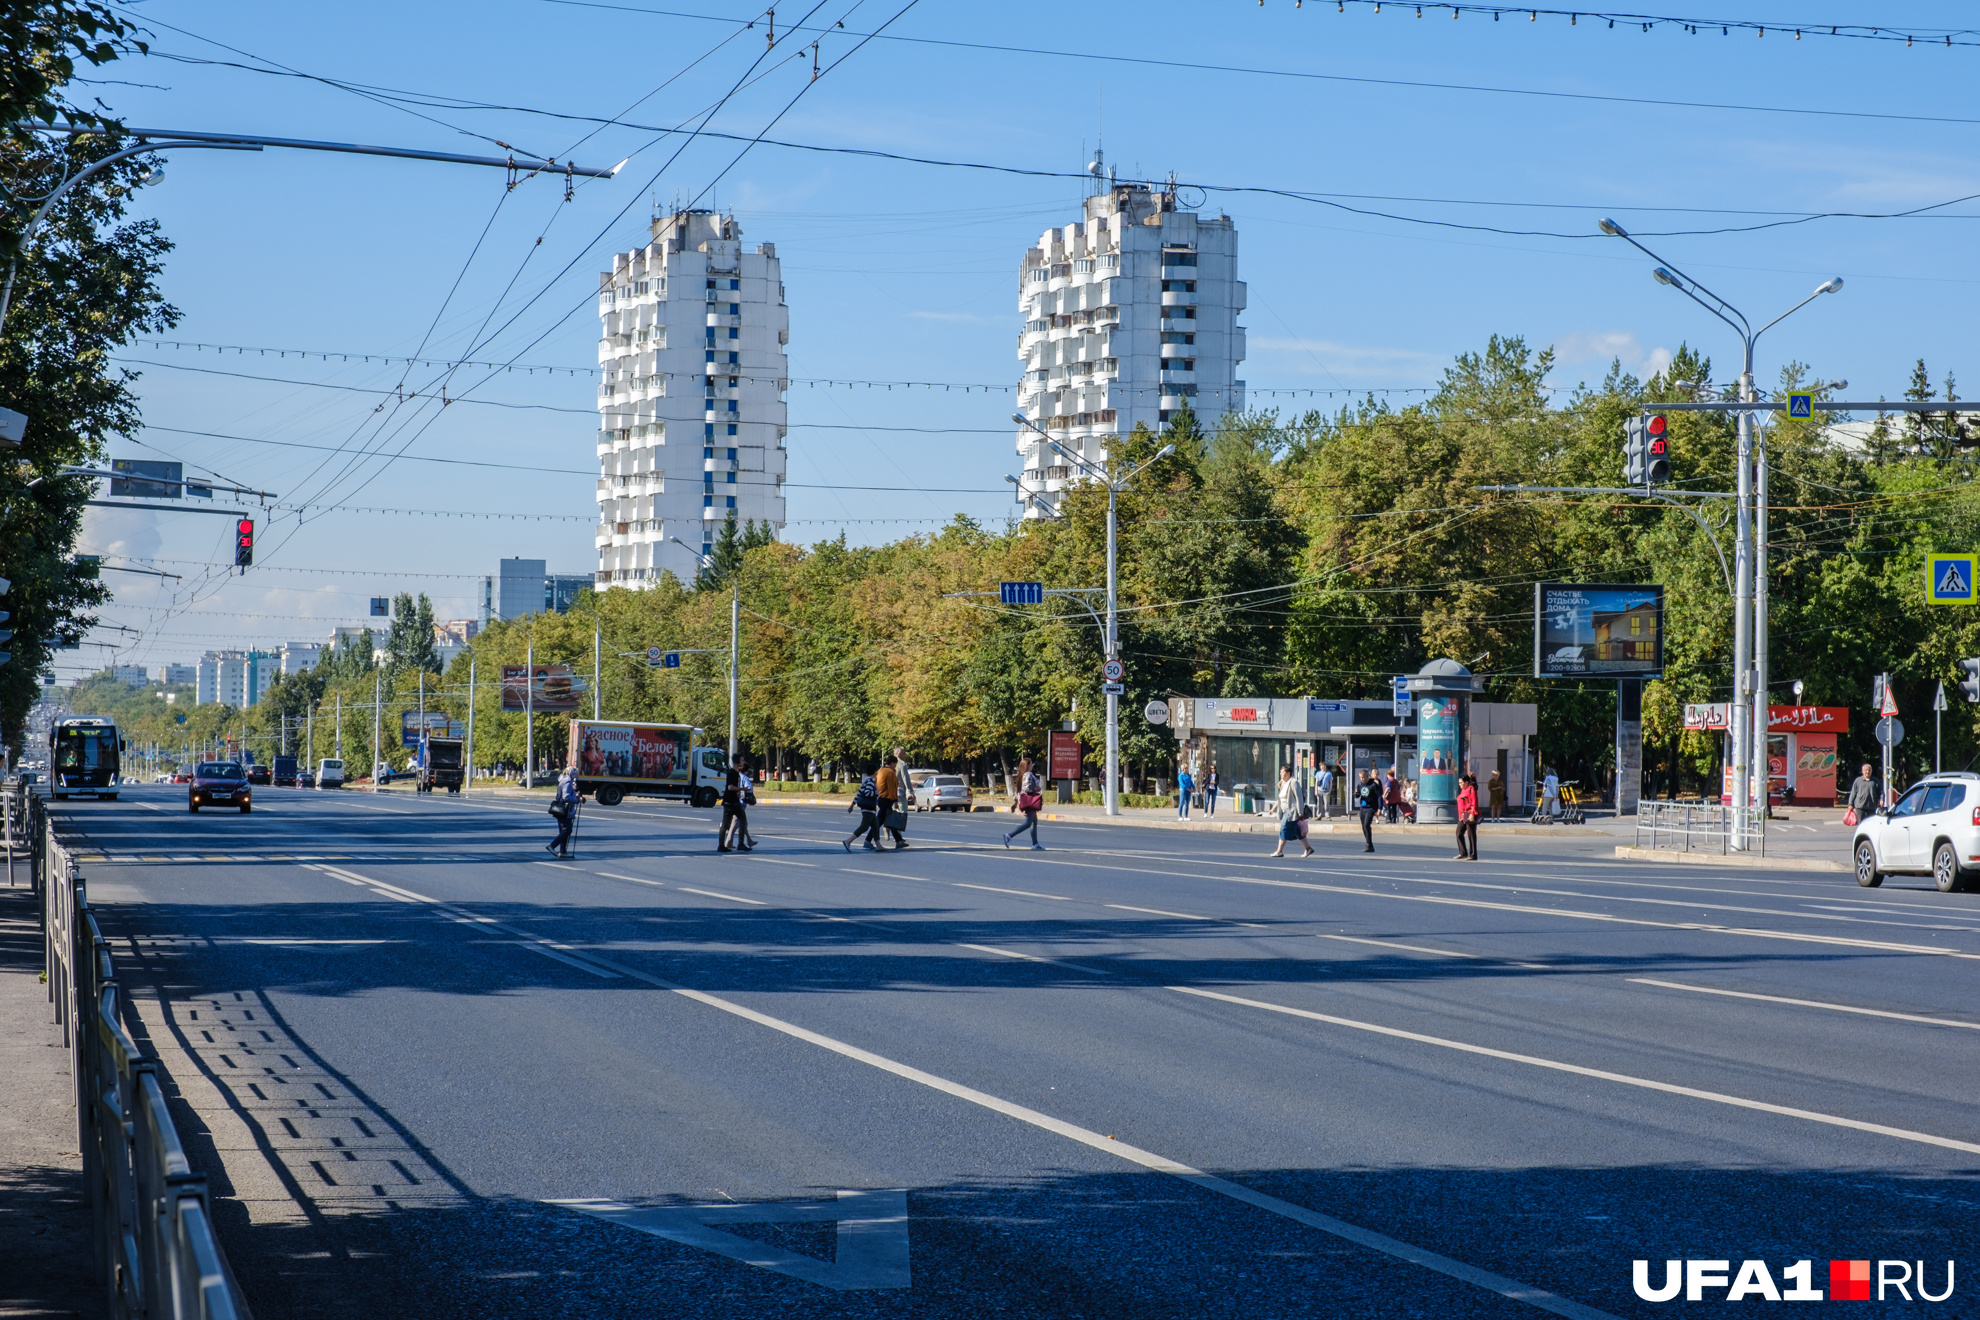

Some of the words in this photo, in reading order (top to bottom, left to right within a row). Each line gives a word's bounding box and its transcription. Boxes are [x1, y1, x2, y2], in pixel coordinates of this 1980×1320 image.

[1652, 442, 1664, 454] 30
[241, 537, 251, 546] 30
[1107, 666, 1120, 675] 50
[582, 726, 630, 741] Красное
[635, 738, 673, 754] Белое
